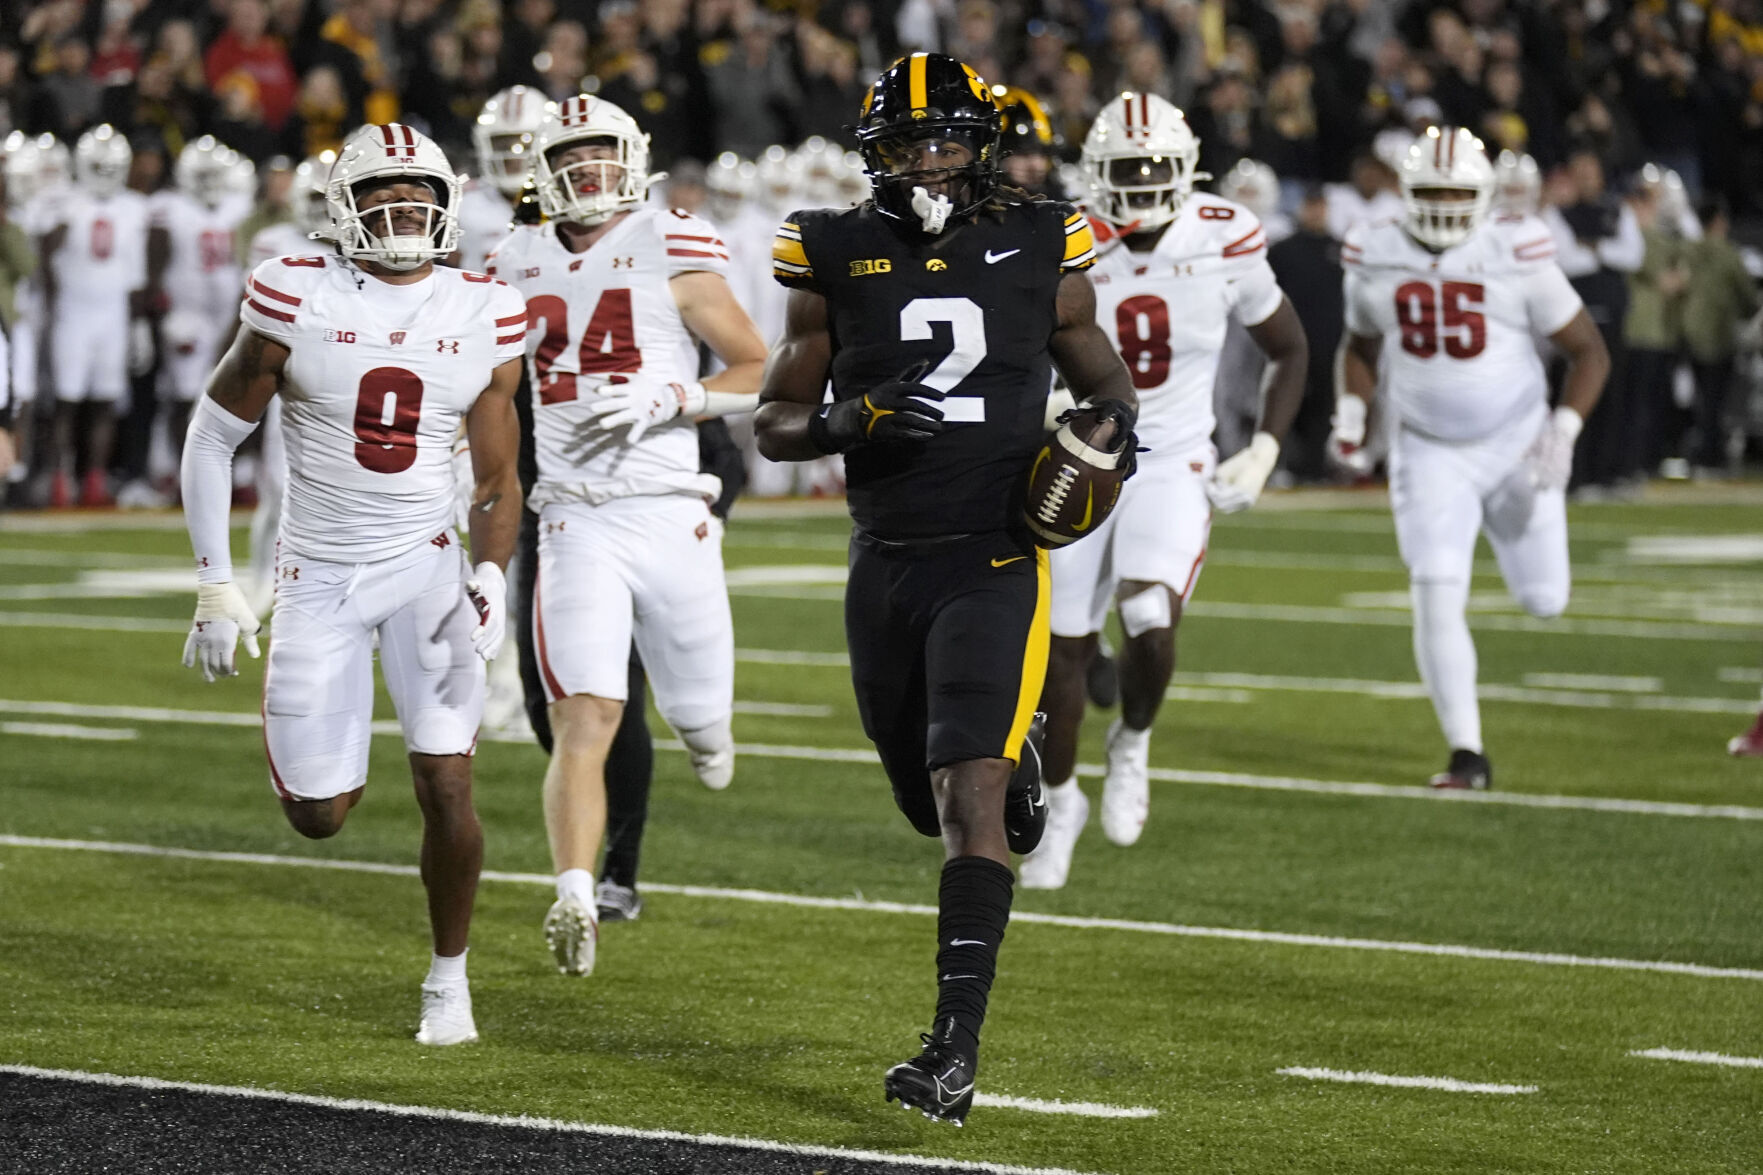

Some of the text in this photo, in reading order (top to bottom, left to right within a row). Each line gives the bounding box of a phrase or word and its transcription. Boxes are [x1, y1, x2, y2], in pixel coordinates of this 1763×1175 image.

[526, 288, 642, 405] 24
[900, 297, 988, 423] 2
[1116, 295, 1172, 390] 8
[1395, 281, 1486, 360] 95
